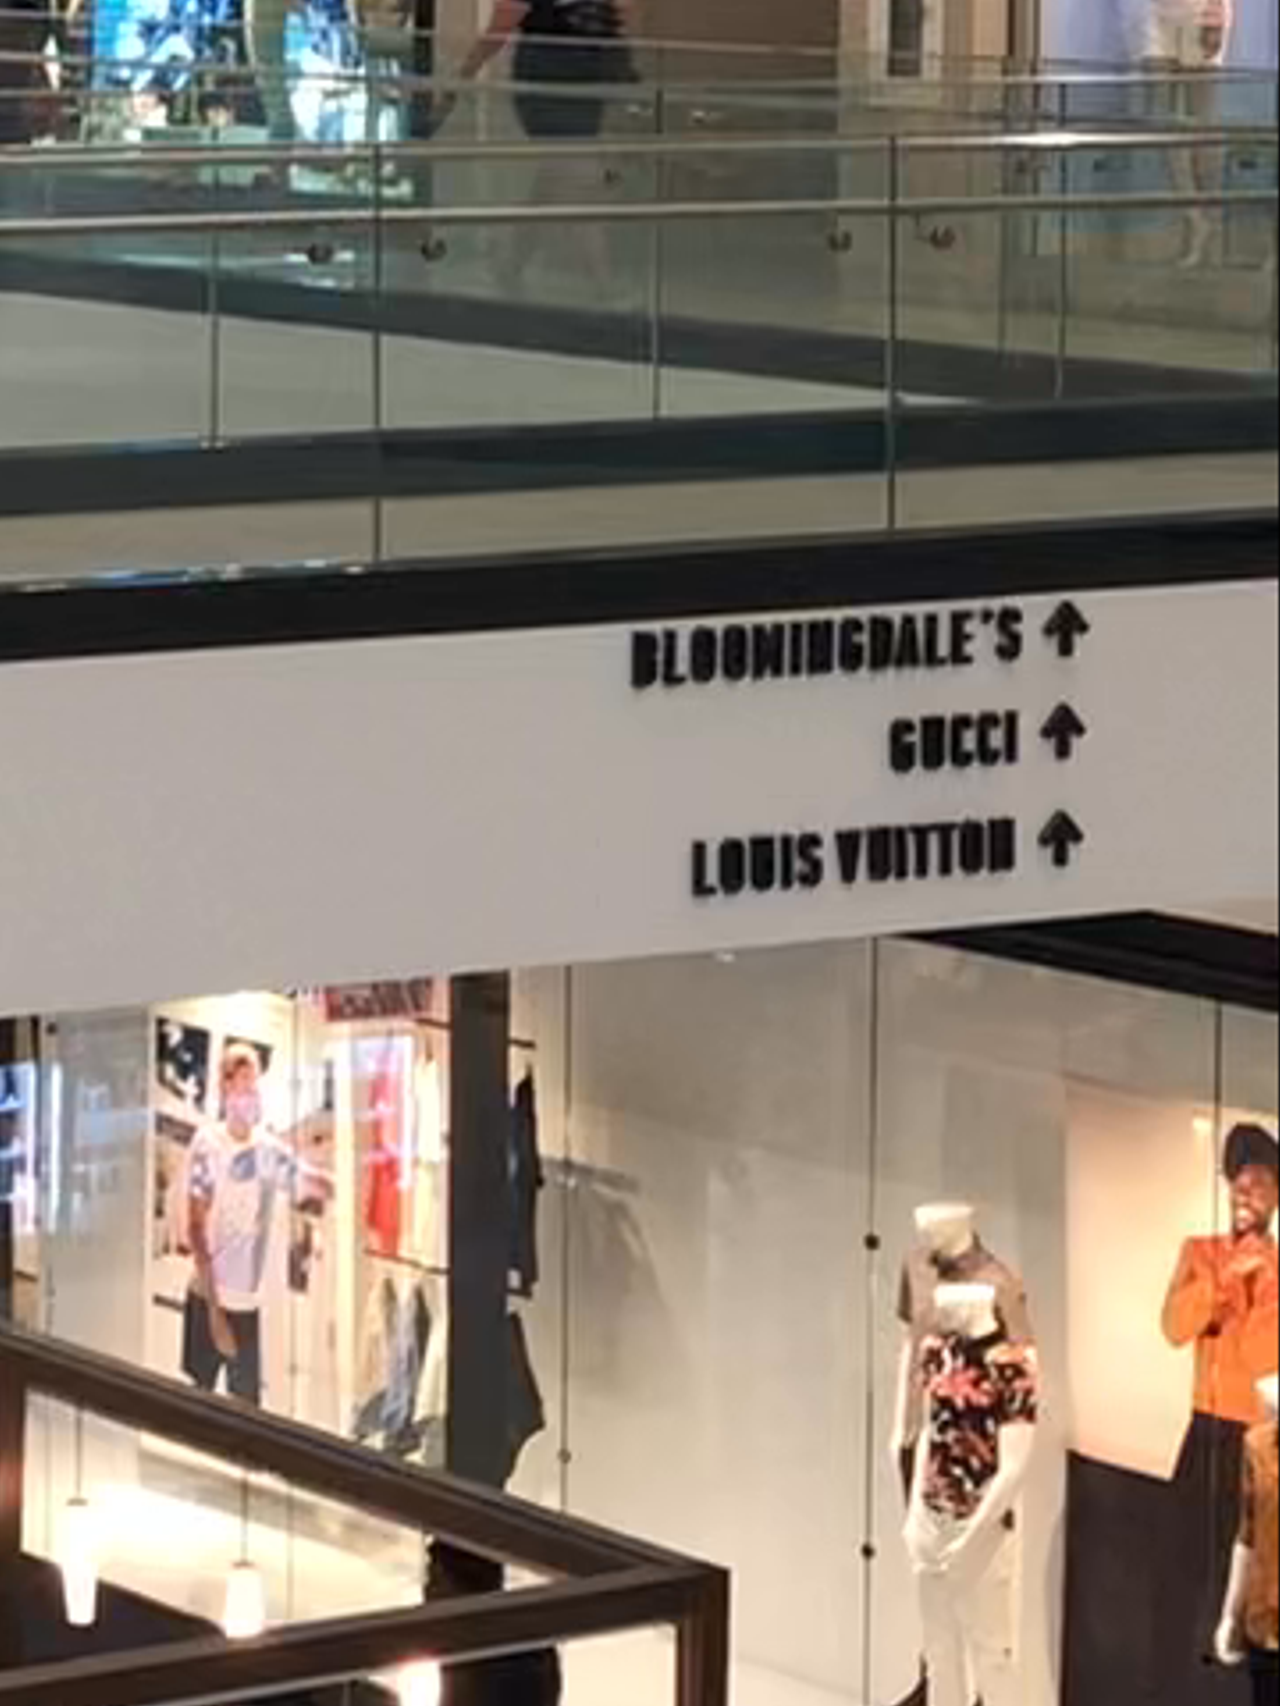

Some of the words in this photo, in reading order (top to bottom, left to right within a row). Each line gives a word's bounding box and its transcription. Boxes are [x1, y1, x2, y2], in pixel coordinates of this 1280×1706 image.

[631, 607, 1023, 689] BLOOMINGDALE'S
[888, 710, 1018, 773] GUCCI
[691, 833, 823, 898] LOUIS
[835, 818, 1016, 886] VUITTON
